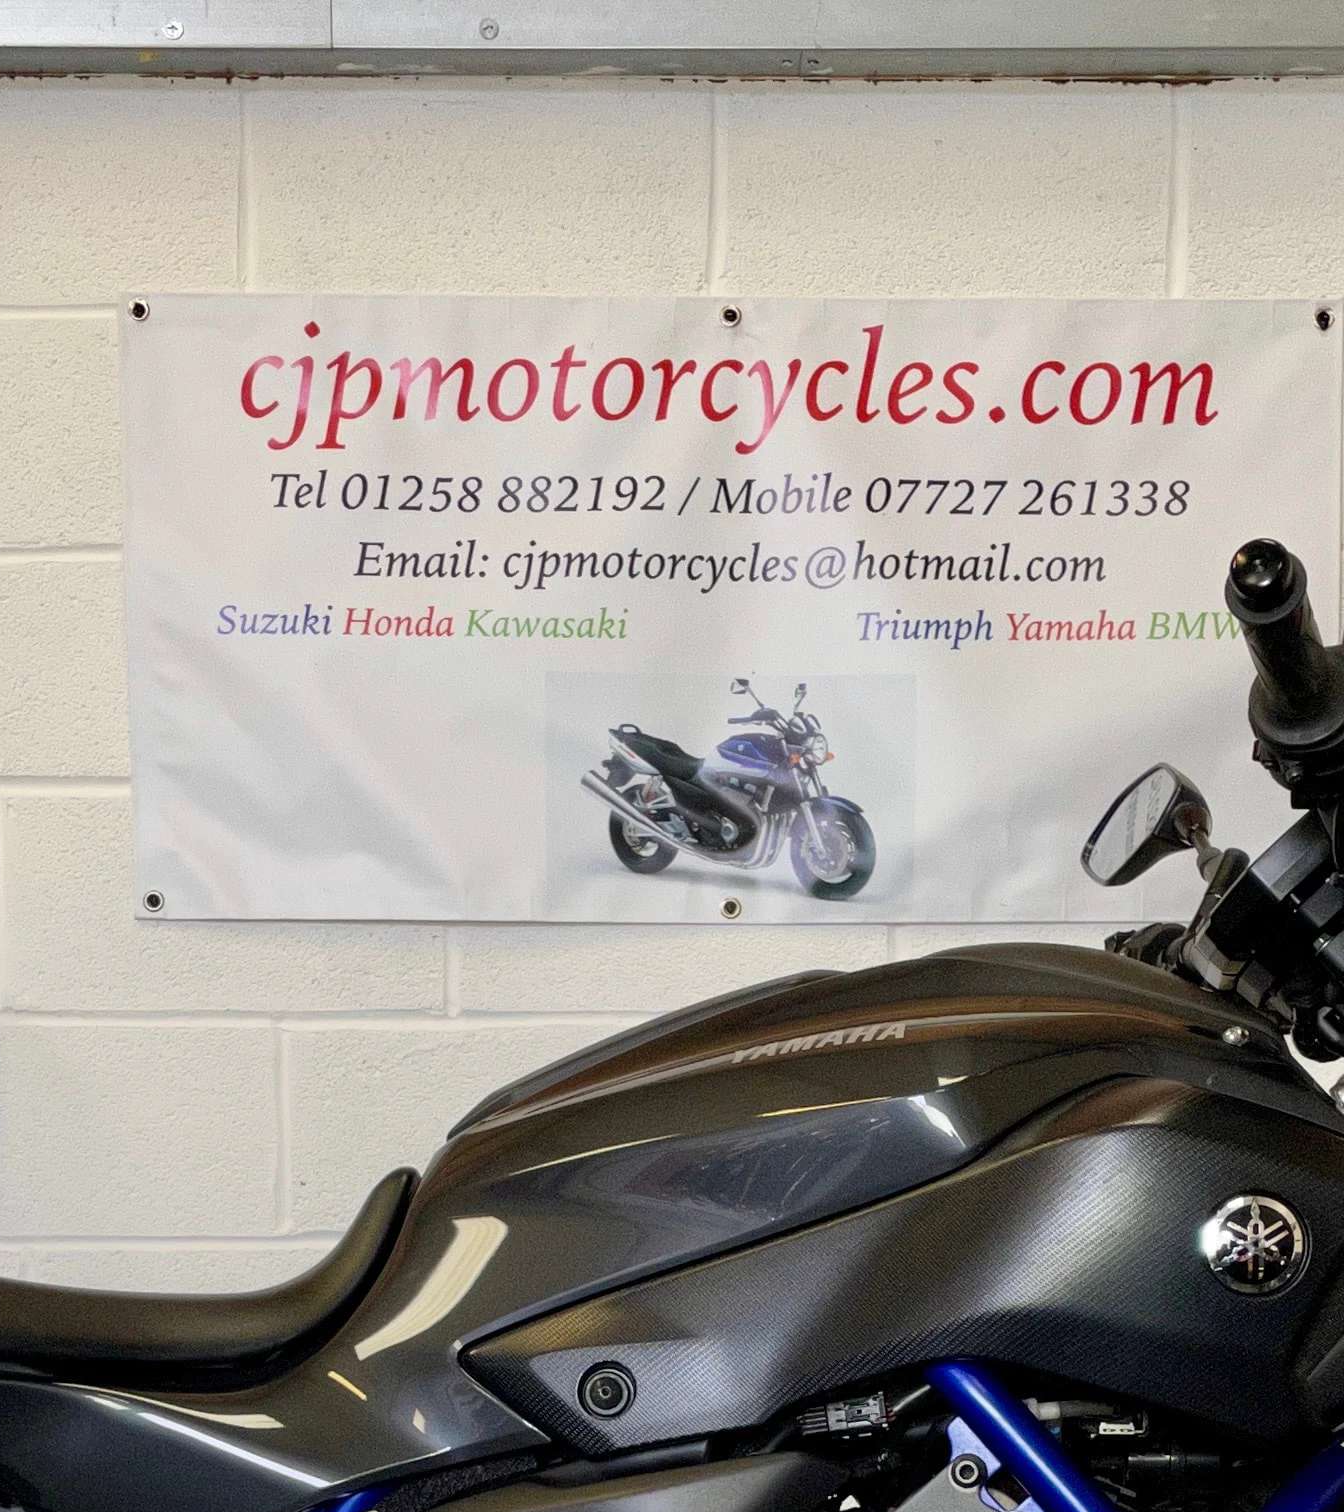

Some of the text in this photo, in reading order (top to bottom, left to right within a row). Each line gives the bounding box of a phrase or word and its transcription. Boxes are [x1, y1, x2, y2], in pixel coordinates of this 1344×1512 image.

[240, 321, 1219, 455] cjpmotorcycles.com
[271, 470, 1191, 516] Tel 01258 882192 / Mobile 07727 261338
[353, 540, 1106, 594] Email: cjpmotorcycles@hotmail.com
[217, 604, 629, 639] Suzuki Honda Kawasaki
[857, 609, 993, 650] Triumph
[1007, 609, 1136, 641] Yamaha
[731, 1021, 908, 1064] YAMAHA
